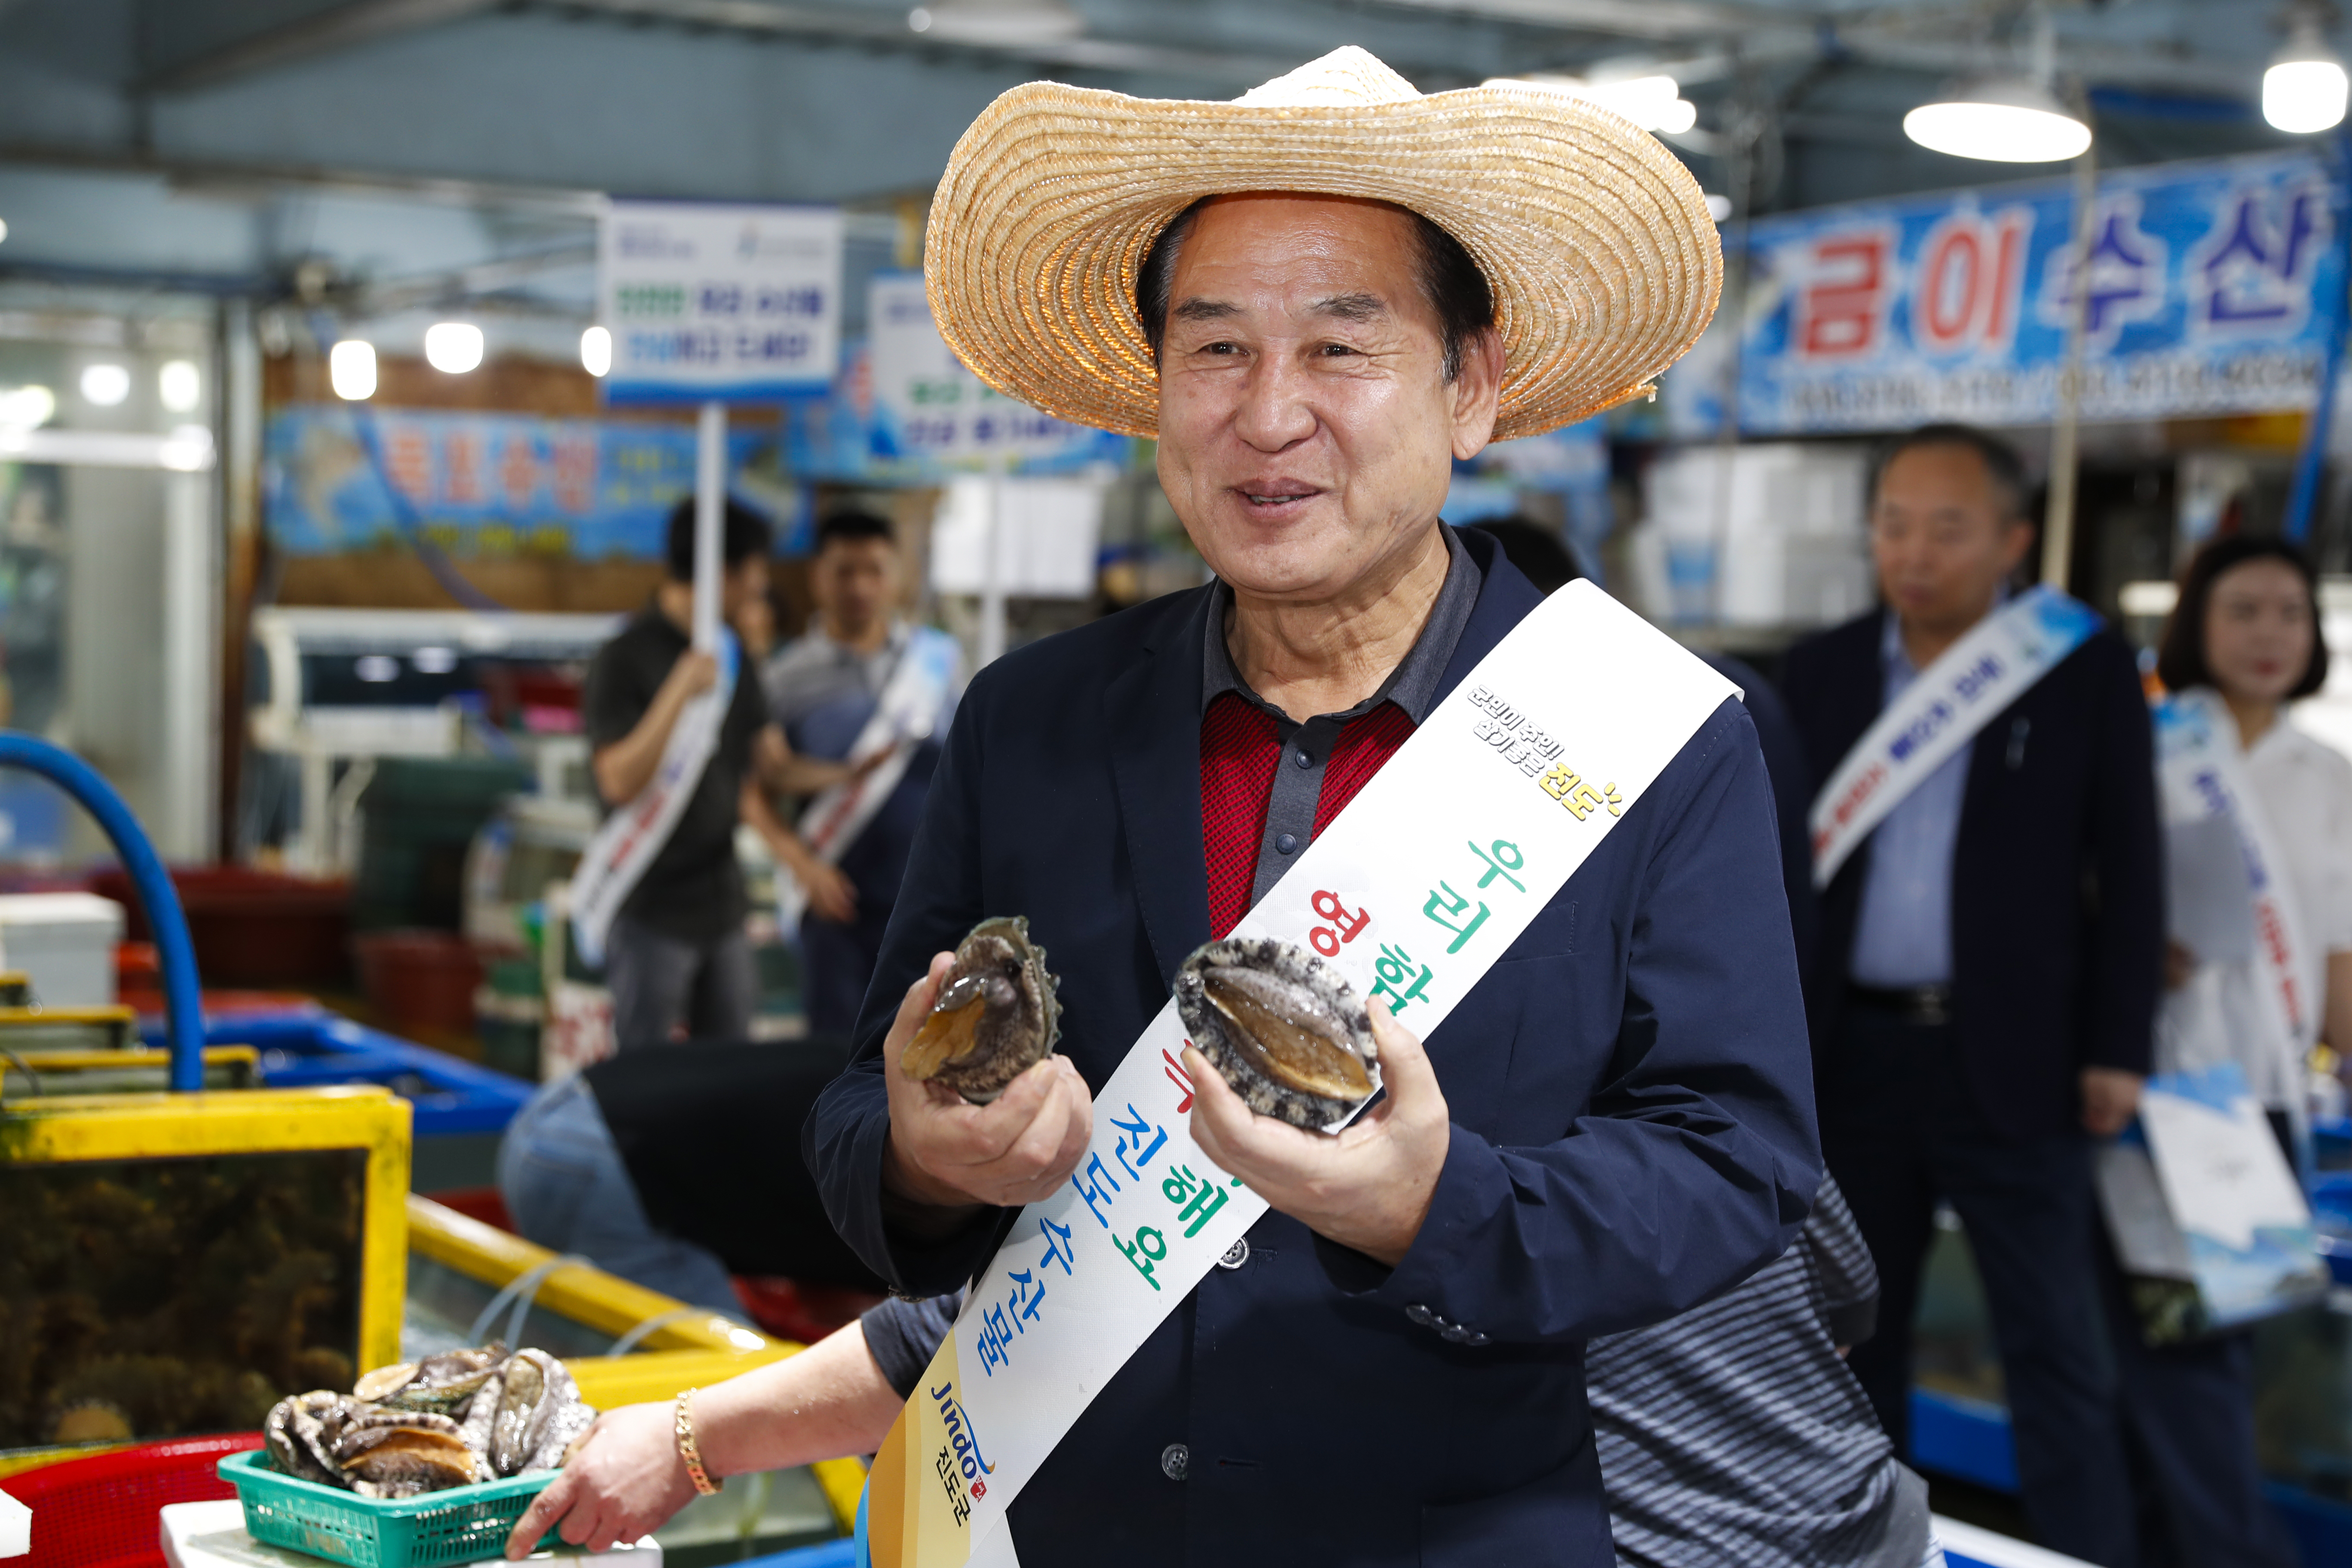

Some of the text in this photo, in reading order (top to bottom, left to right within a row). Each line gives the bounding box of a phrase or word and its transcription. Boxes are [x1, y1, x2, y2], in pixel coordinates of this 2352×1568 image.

[1467, 684, 1565, 760] 군민이 주인!
[1539, 762, 1604, 821] 진도
[1422, 839, 1526, 955] 우리
[1071, 1102, 1169, 1229] 진도
[977, 1217, 1074, 1377] 수산물
[936, 1445, 971, 1528] 진도군
